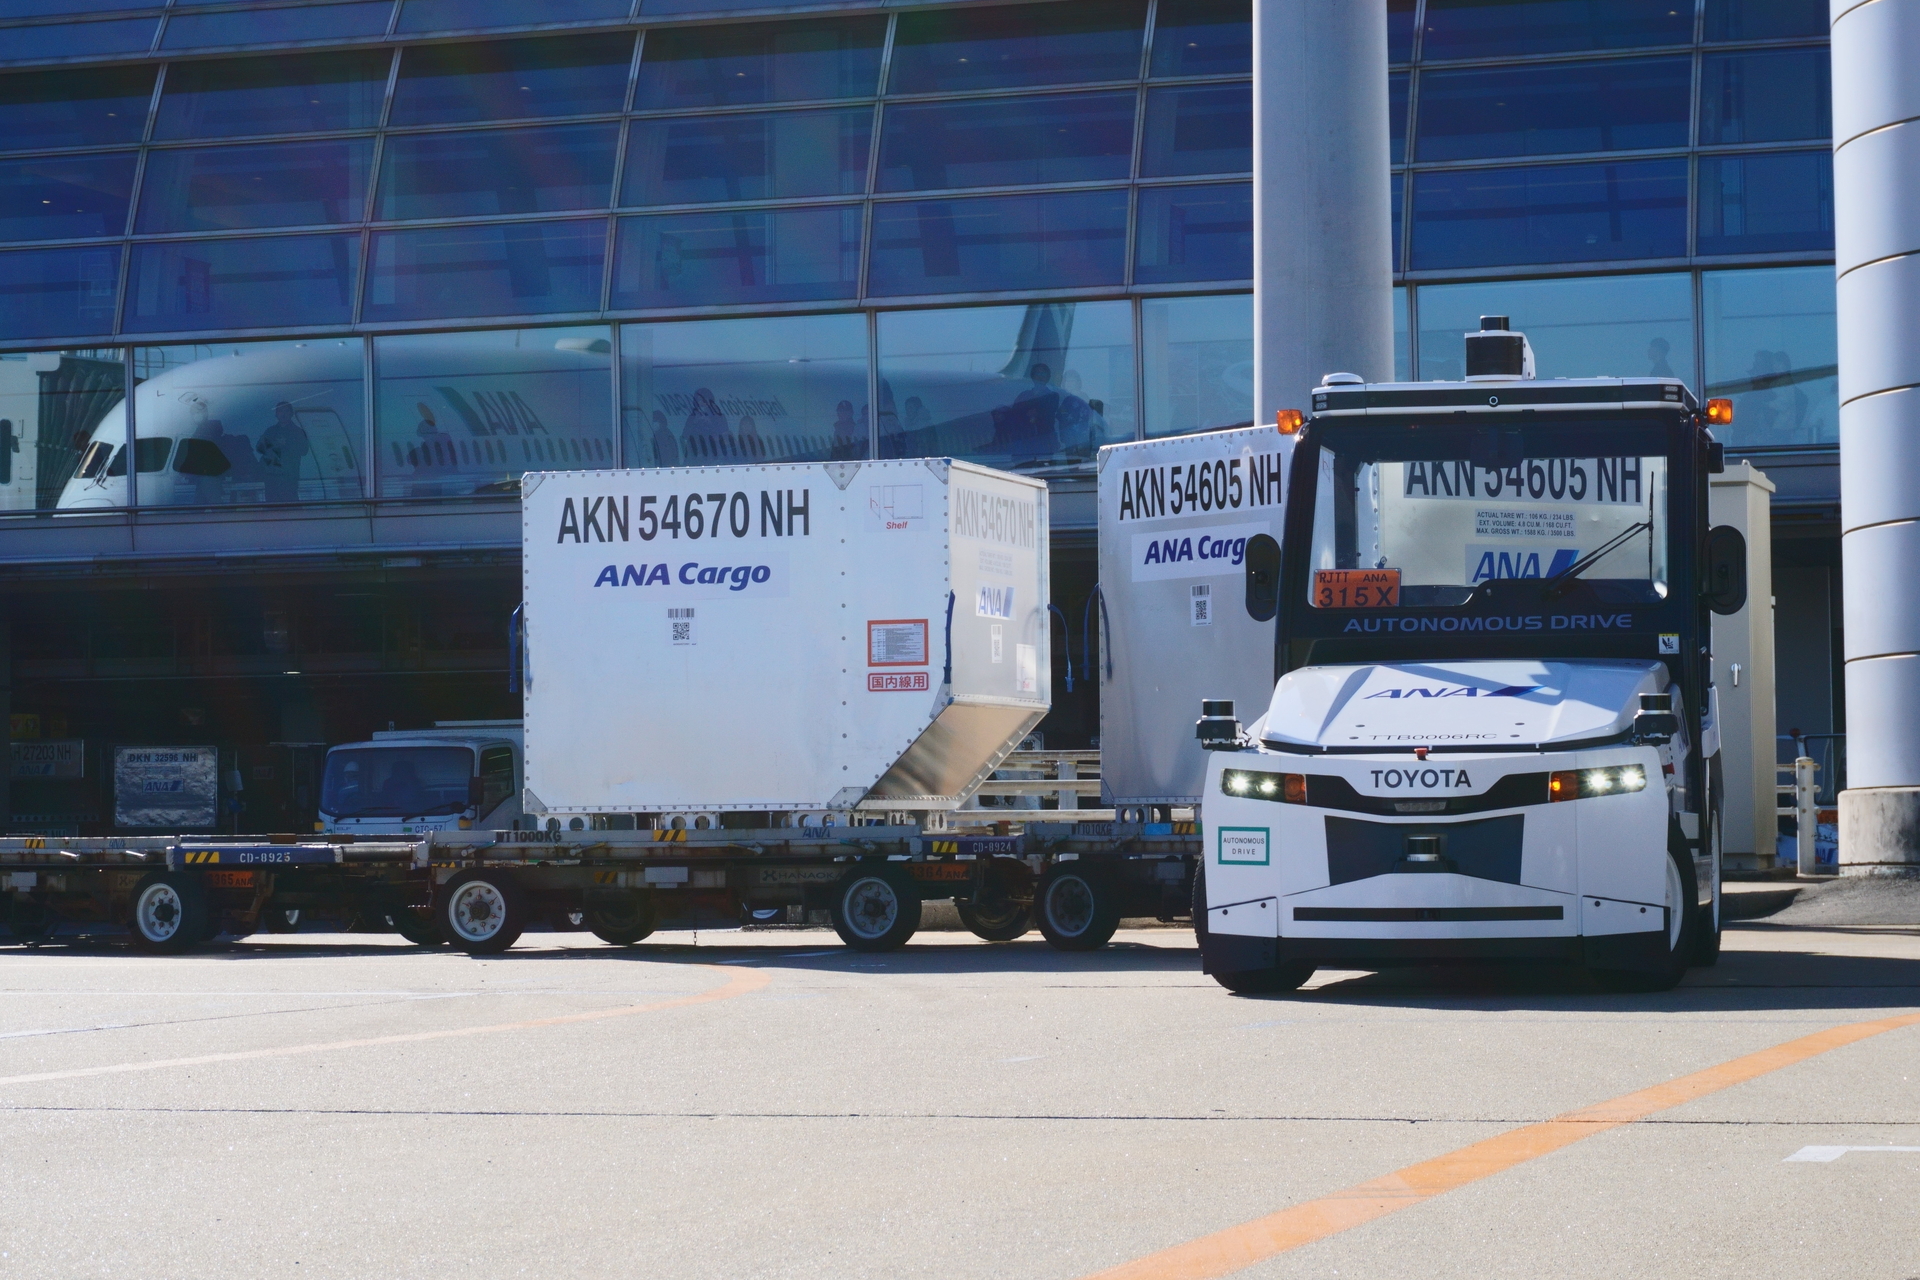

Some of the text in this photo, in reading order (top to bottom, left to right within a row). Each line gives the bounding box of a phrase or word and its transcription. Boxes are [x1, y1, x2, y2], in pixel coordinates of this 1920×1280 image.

[1119, 452, 1282, 521] AKN 54605 NH
[1405, 461, 1475, 497] AKN
[1597, 458, 1641, 503] NH
[557, 488, 810, 544] AKN 54670 NH
[955, 487, 1035, 549] AKN 54670 NH
[1476, 511, 1499, 519] ACTUAL
[886, 521, 908, 530] Shelf
[1143, 535, 1248, 566] ANA Carg
[1471, 551, 1541, 583] ANA
[593, 561, 771, 592] ANA Cargo
[1319, 572, 1388, 584] RJTT ANA
[978, 586, 1003, 617] ANA
[1343, 613, 1632, 633] AUTONOMOUS DRIVE
[871, 675, 925, 690] 国内線用
[1362, 686, 1478, 700] ANA
[1368, 733, 1498, 741] TTB0006RC
[23, 745, 55, 761] 27203
[57, 745, 71, 760] NH
[129, 753, 198, 763] DKN 32596 NH
[144, 781, 169, 792] ANA
[1370, 769, 1472, 789] TOYOTA
[801, 828, 831, 838] ANA
[972, 841, 1011, 853] CD-8924
[1223, 837, 1265, 845] AUTONOMOUS
[239, 852, 291, 864] CD-8925
